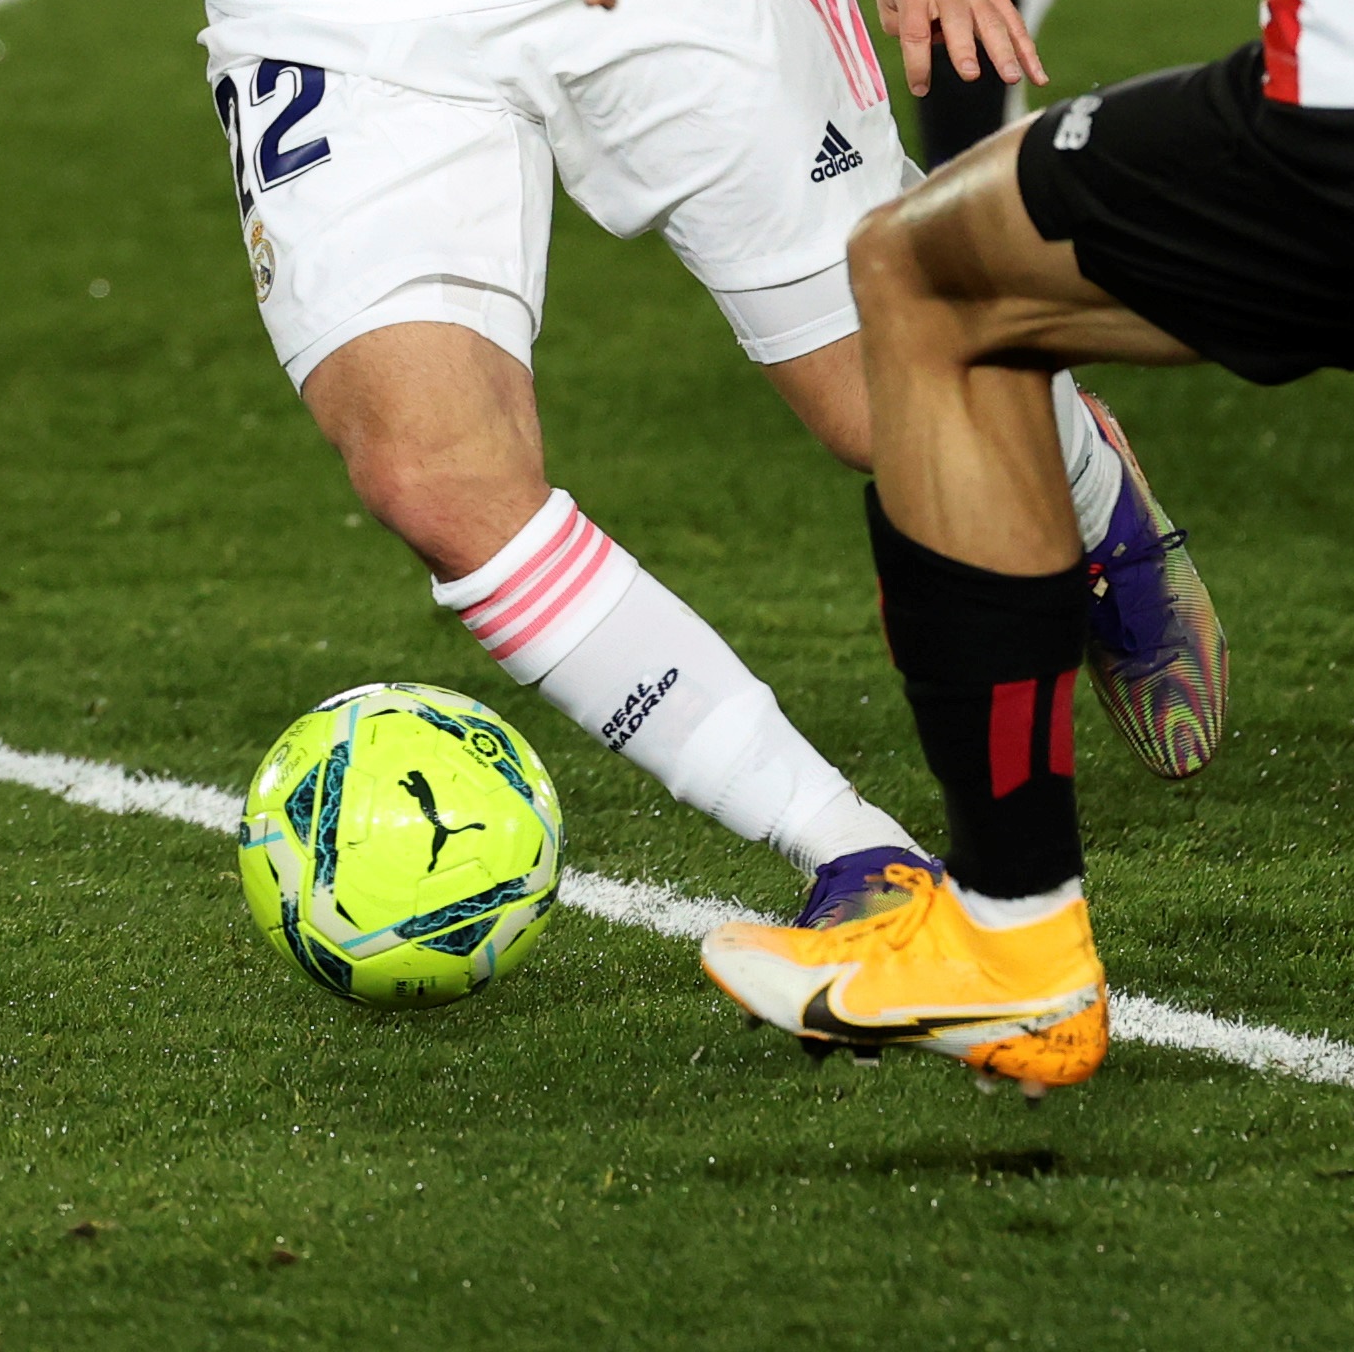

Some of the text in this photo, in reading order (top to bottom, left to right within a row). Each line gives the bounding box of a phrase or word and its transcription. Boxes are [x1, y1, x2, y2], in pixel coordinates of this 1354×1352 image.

[810, 150, 863, 183] adidas
[602, 682, 654, 738] REAL
[609, 667, 679, 754] MADRID
